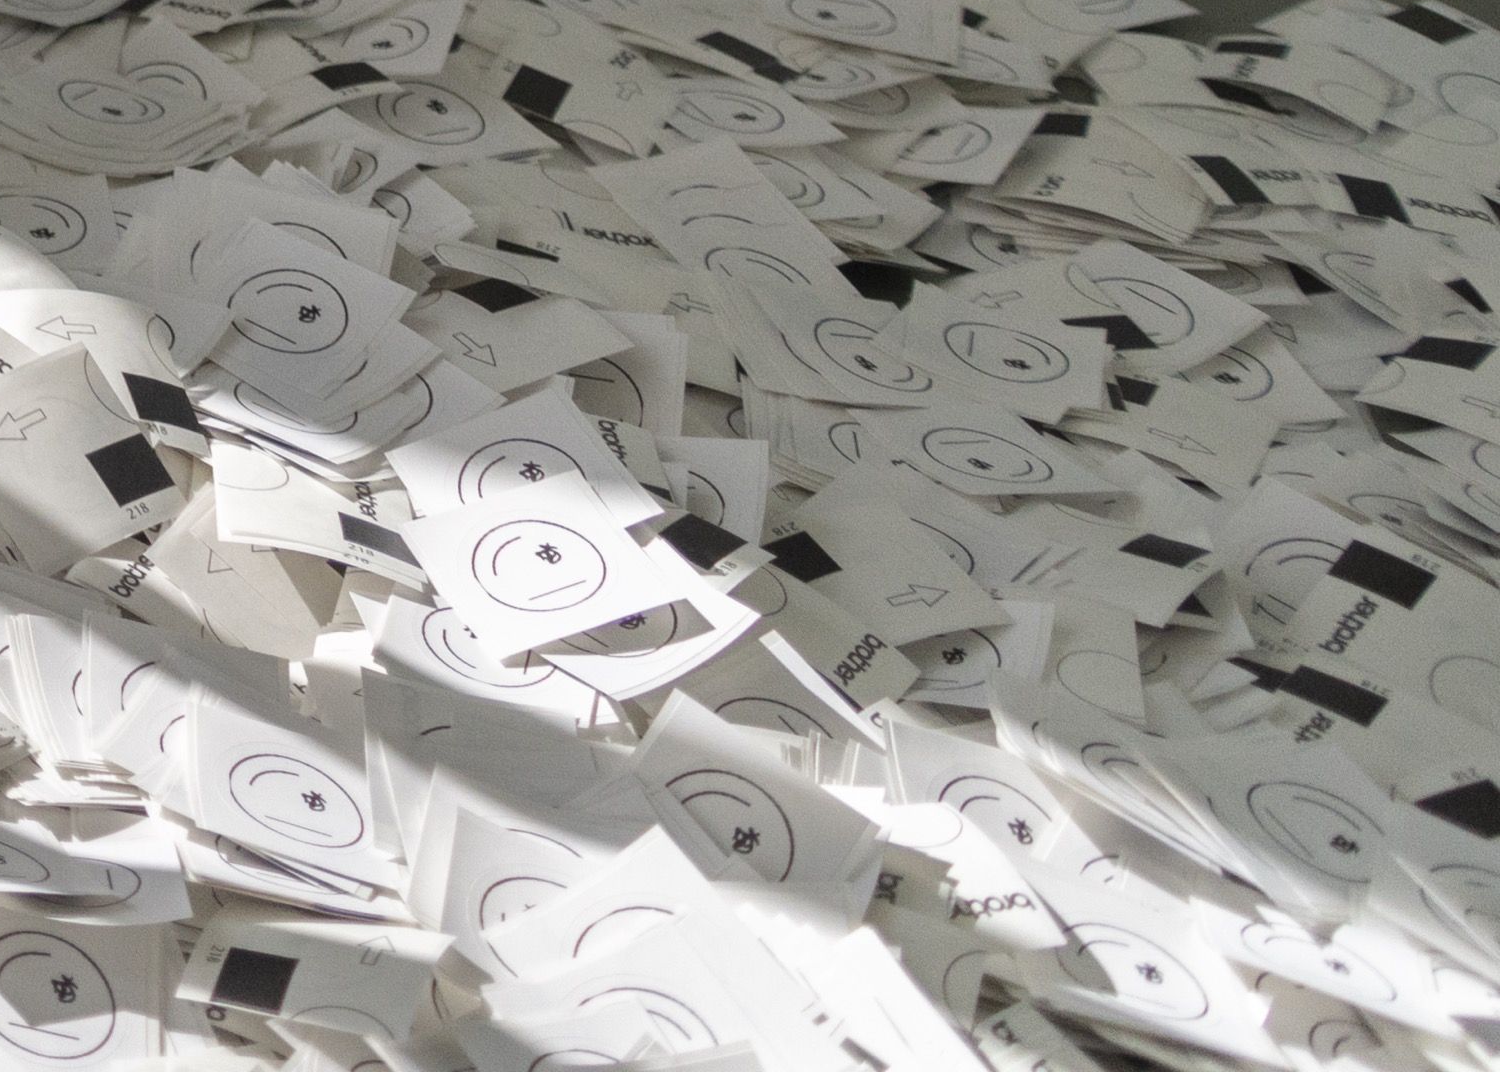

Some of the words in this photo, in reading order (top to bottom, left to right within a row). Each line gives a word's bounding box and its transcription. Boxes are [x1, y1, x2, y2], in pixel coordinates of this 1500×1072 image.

[128, 502, 151, 521] 218
[108, 553, 156, 599] brothe
[1318, 595, 1379, 655] brother
[832, 633, 888, 686] brother
